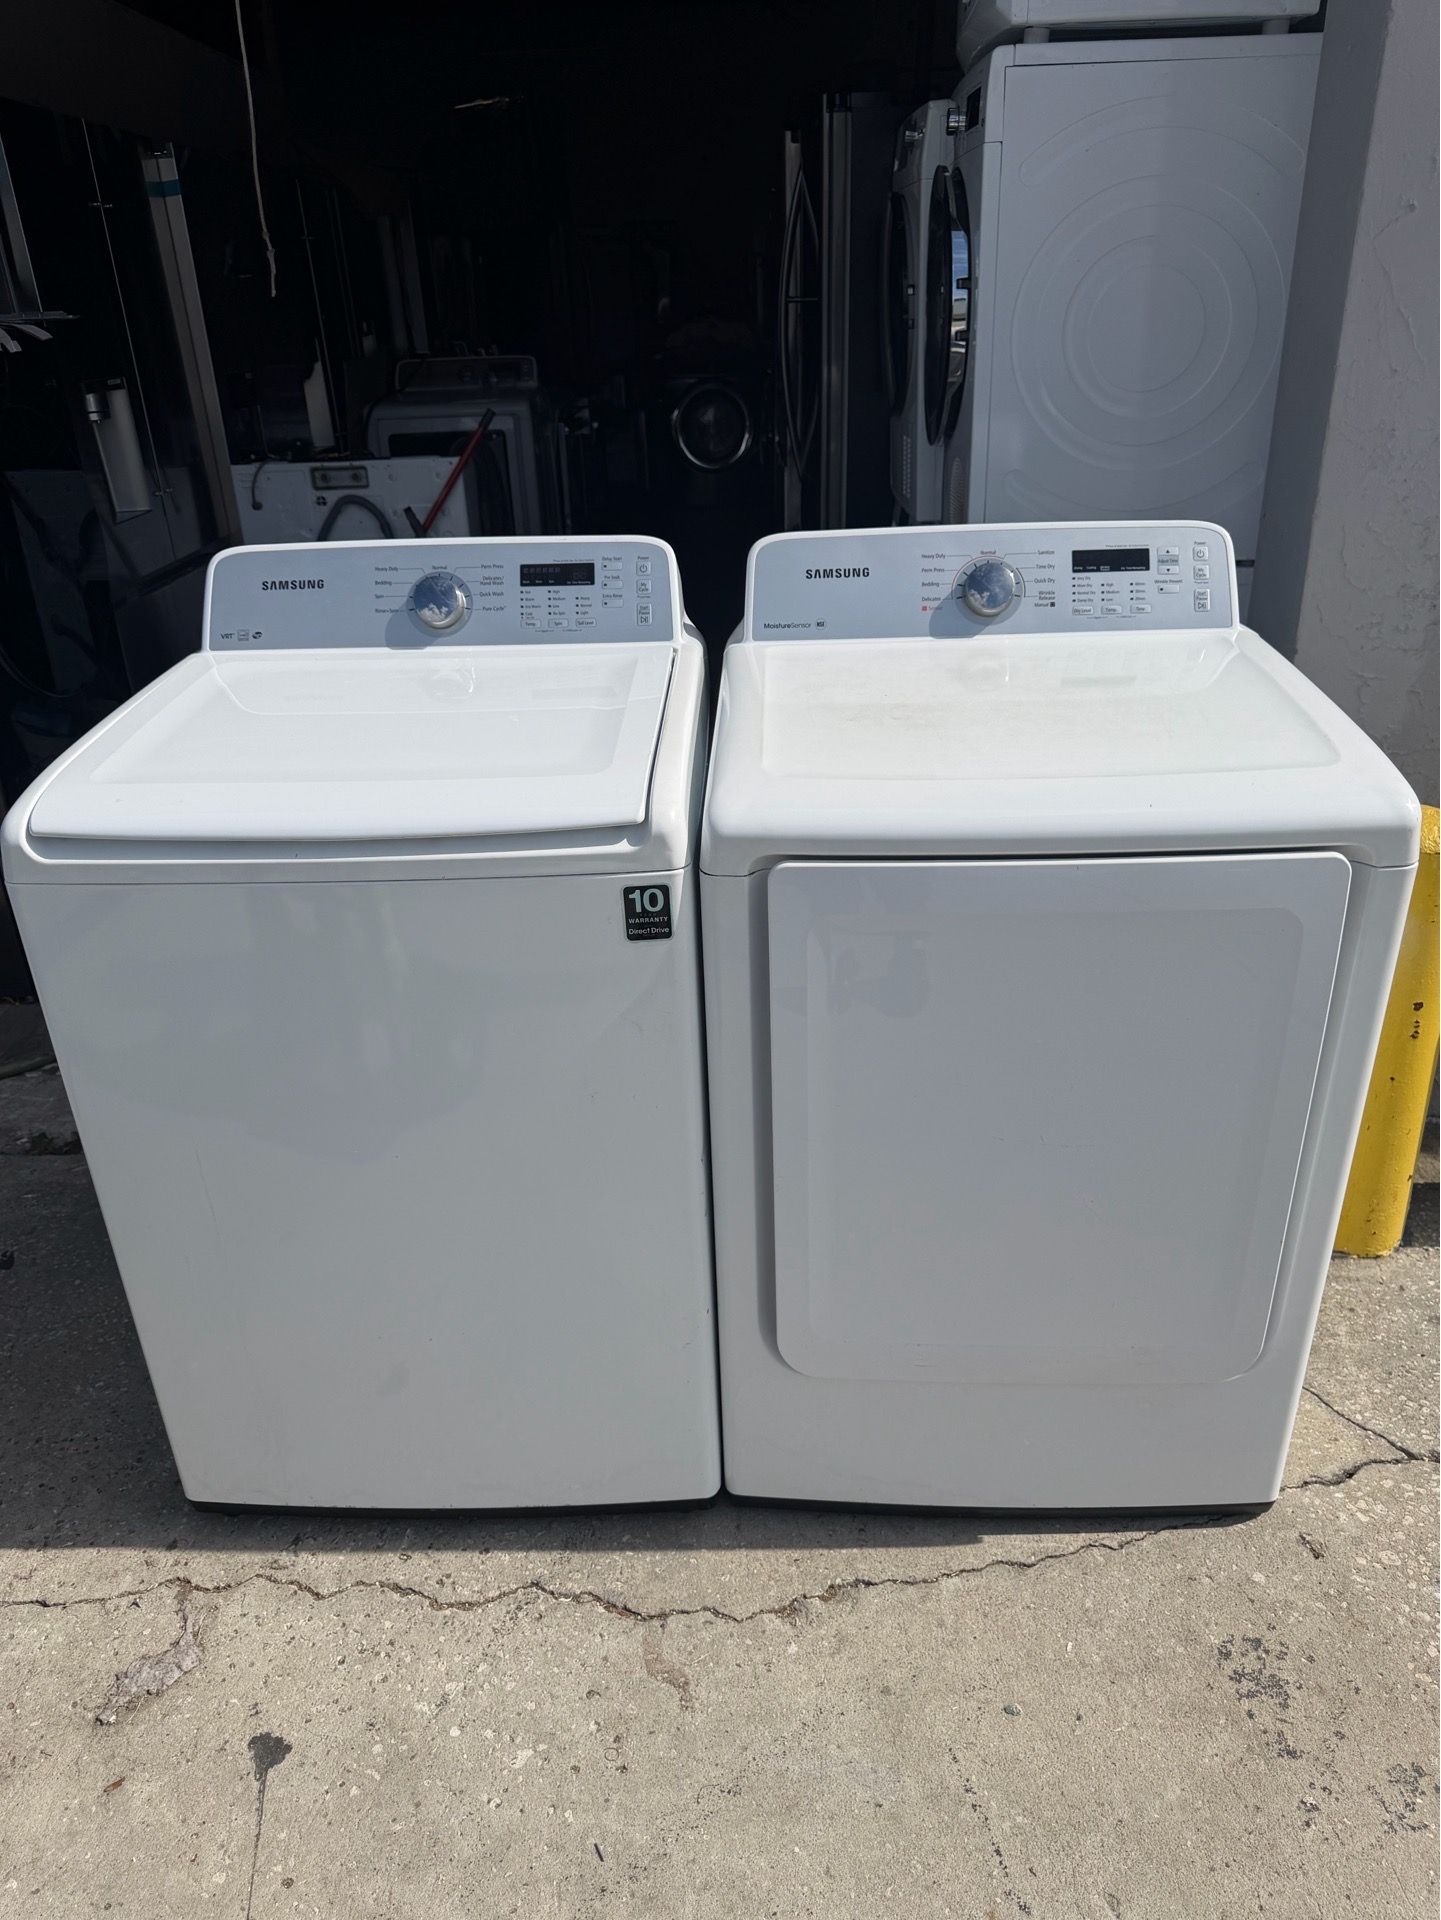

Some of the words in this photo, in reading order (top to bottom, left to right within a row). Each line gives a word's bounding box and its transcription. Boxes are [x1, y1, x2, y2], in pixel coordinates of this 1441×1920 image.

[806, 567, 870, 579] SAMSUNG
[261, 579, 325, 591] SAMSUNG
[628, 888, 665, 913] 10
[628, 916, 669, 924] WARRANTY
